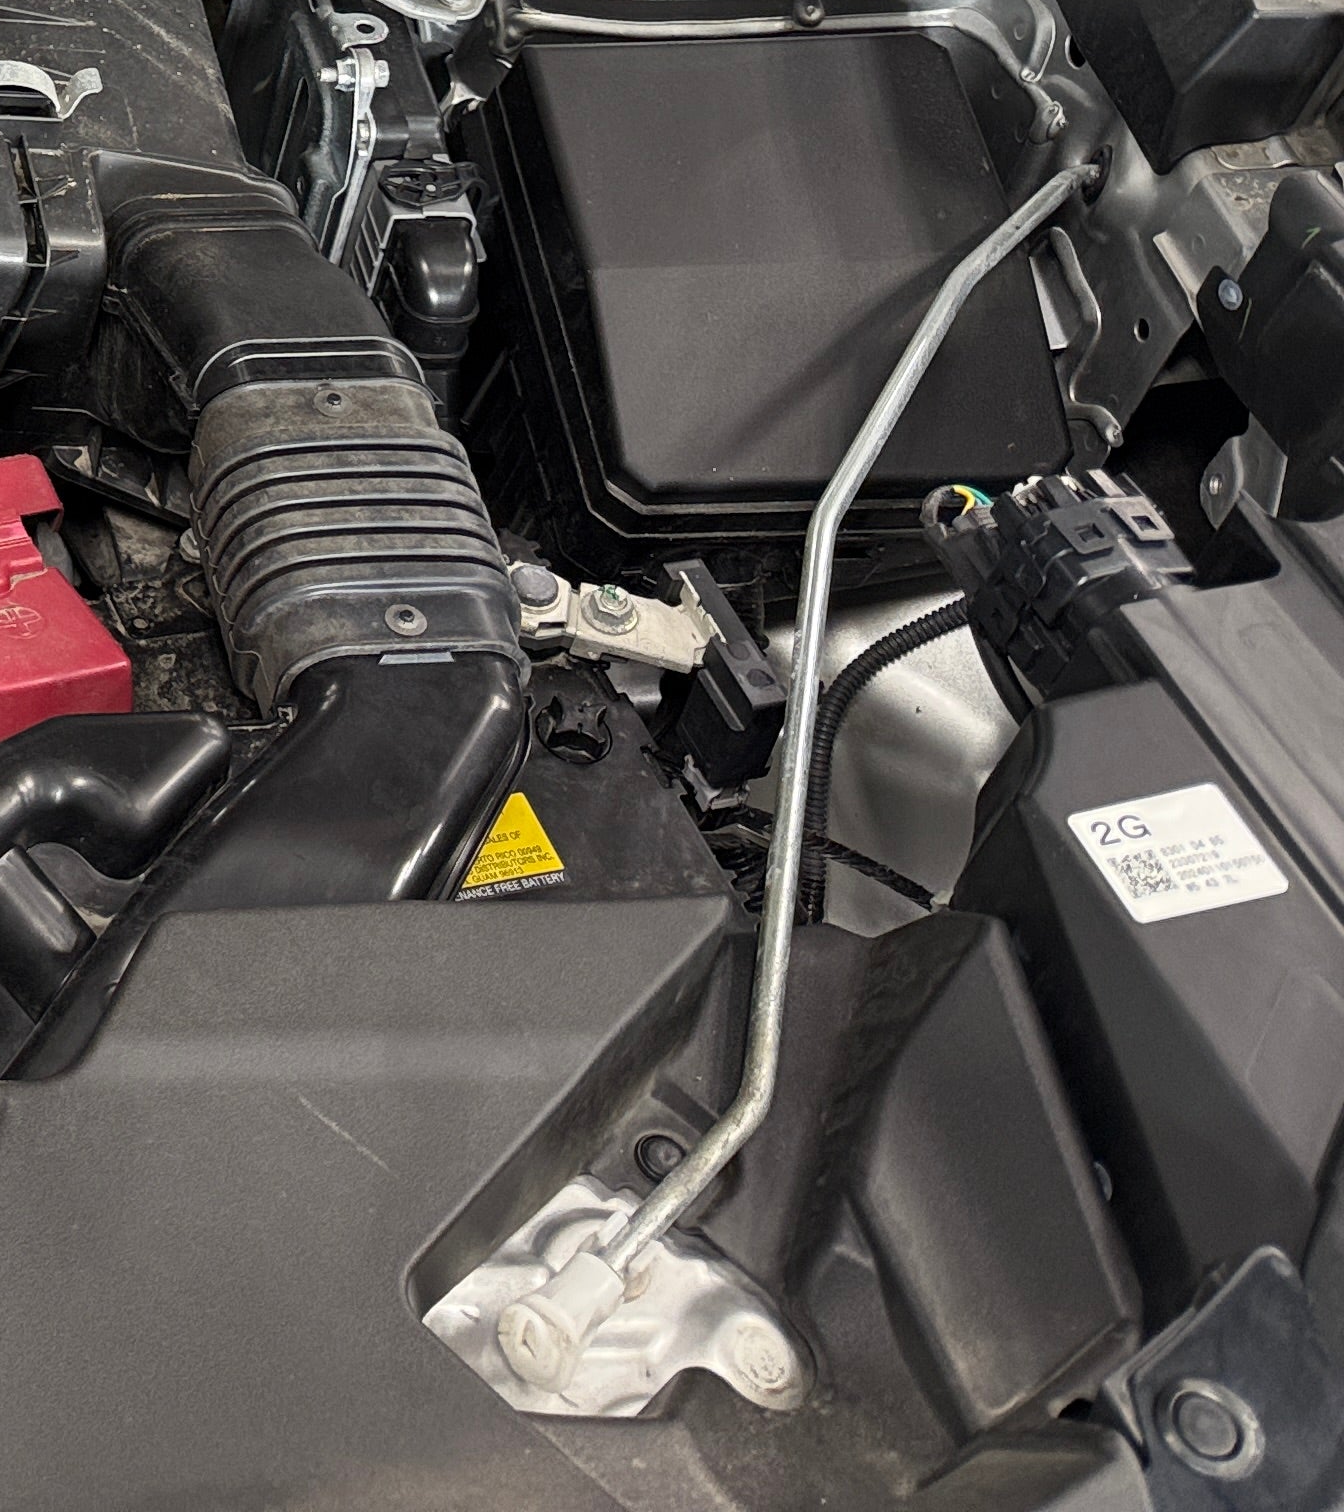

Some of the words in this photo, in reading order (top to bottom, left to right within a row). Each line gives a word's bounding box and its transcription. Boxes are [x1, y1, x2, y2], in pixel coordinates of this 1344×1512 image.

[509, 830, 521, 840] OF
[1090, 814, 1152, 846] 2G
[495, 849, 517, 860] RICO
[474, 854, 537, 874] DISTRIBUTORS
[537, 852, 555, 863] INC.
[471, 873, 498, 884] GUAM
[494, 879, 521, 894] FREE
[521, 871, 565, 888] BATTERY
